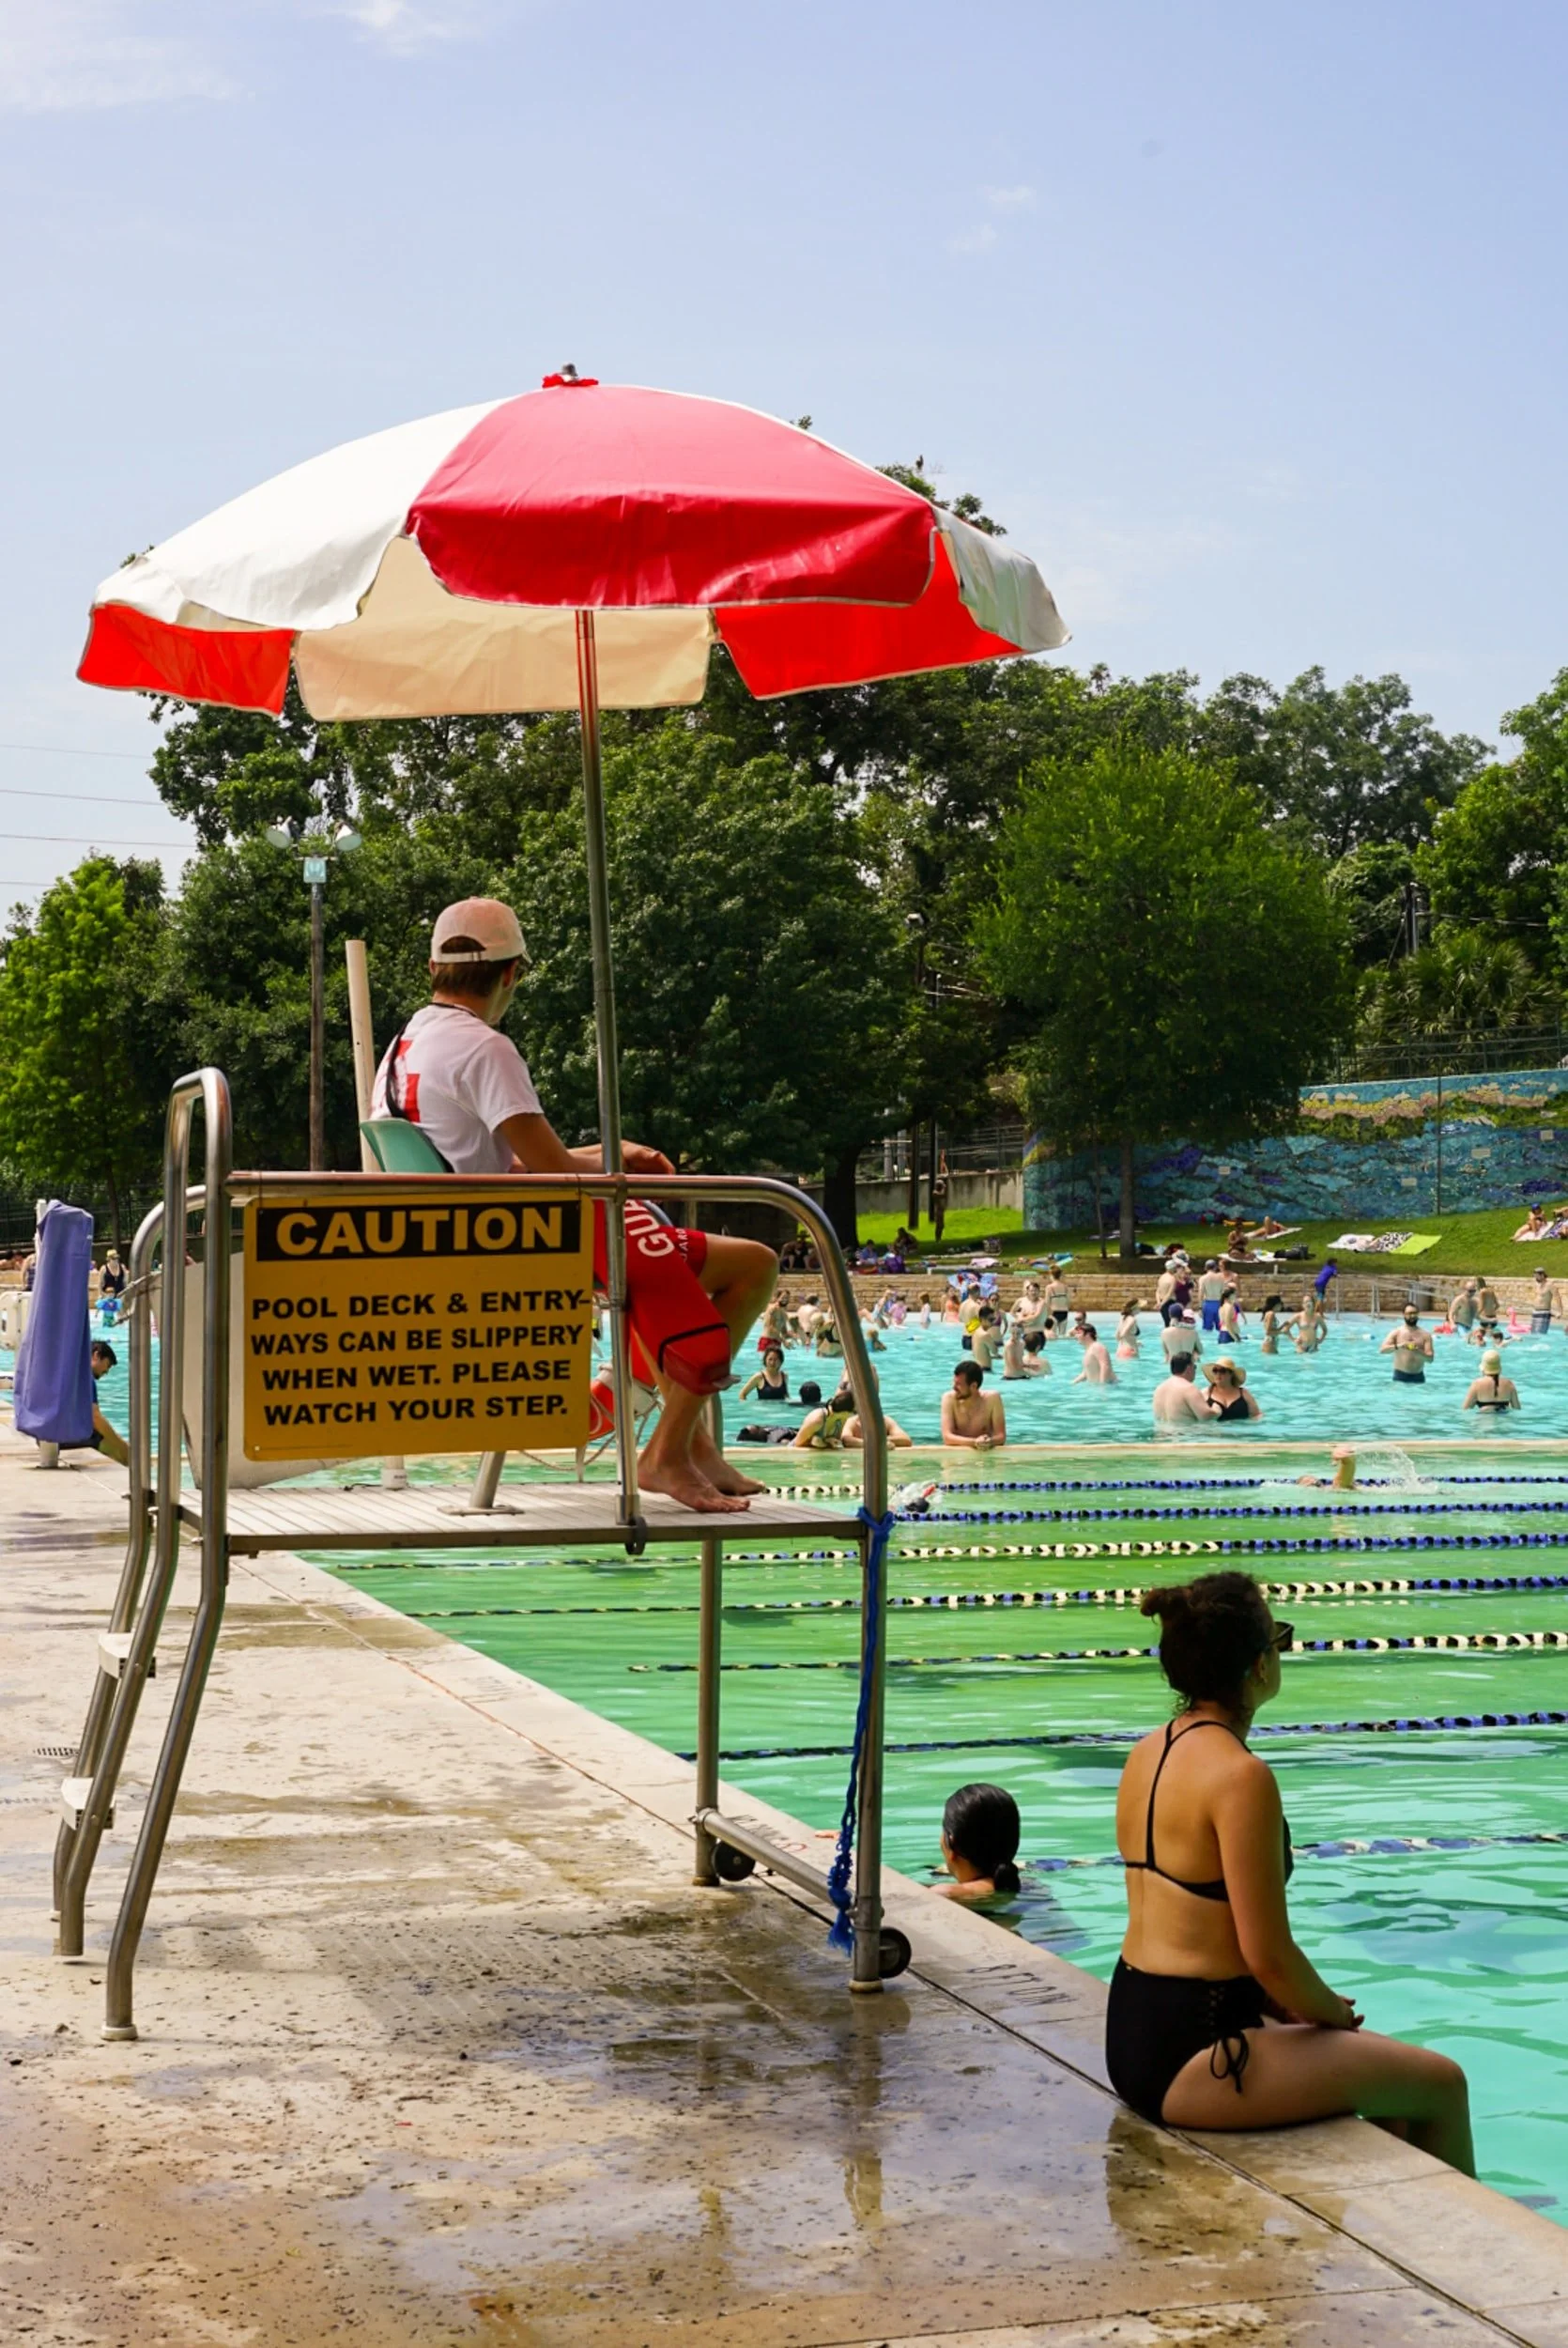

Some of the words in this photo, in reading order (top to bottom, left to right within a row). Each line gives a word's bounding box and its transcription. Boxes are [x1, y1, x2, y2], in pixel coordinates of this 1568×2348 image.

[276, 1206, 562, 1257] CAUTION
[253, 1297, 337, 1320] POOL
[349, 1294, 434, 1317] DECK
[447, 1293, 468, 1313] &
[481, 1290, 591, 1312] ENTRY-
[251, 1333, 328, 1355] WAYS
[339, 1331, 395, 1352] CAN
[407, 1329, 441, 1350] BE
[452, 1324, 583, 1349] SLIPPERY
[263, 1367, 357, 1390] WHEN
[368, 1365, 440, 1386] WET.
[453, 1360, 570, 1383] PLEASE
[264, 1402, 376, 1426] WATCH
[389, 1398, 474, 1420] YOUR
[486, 1395, 567, 1417] STEP.
